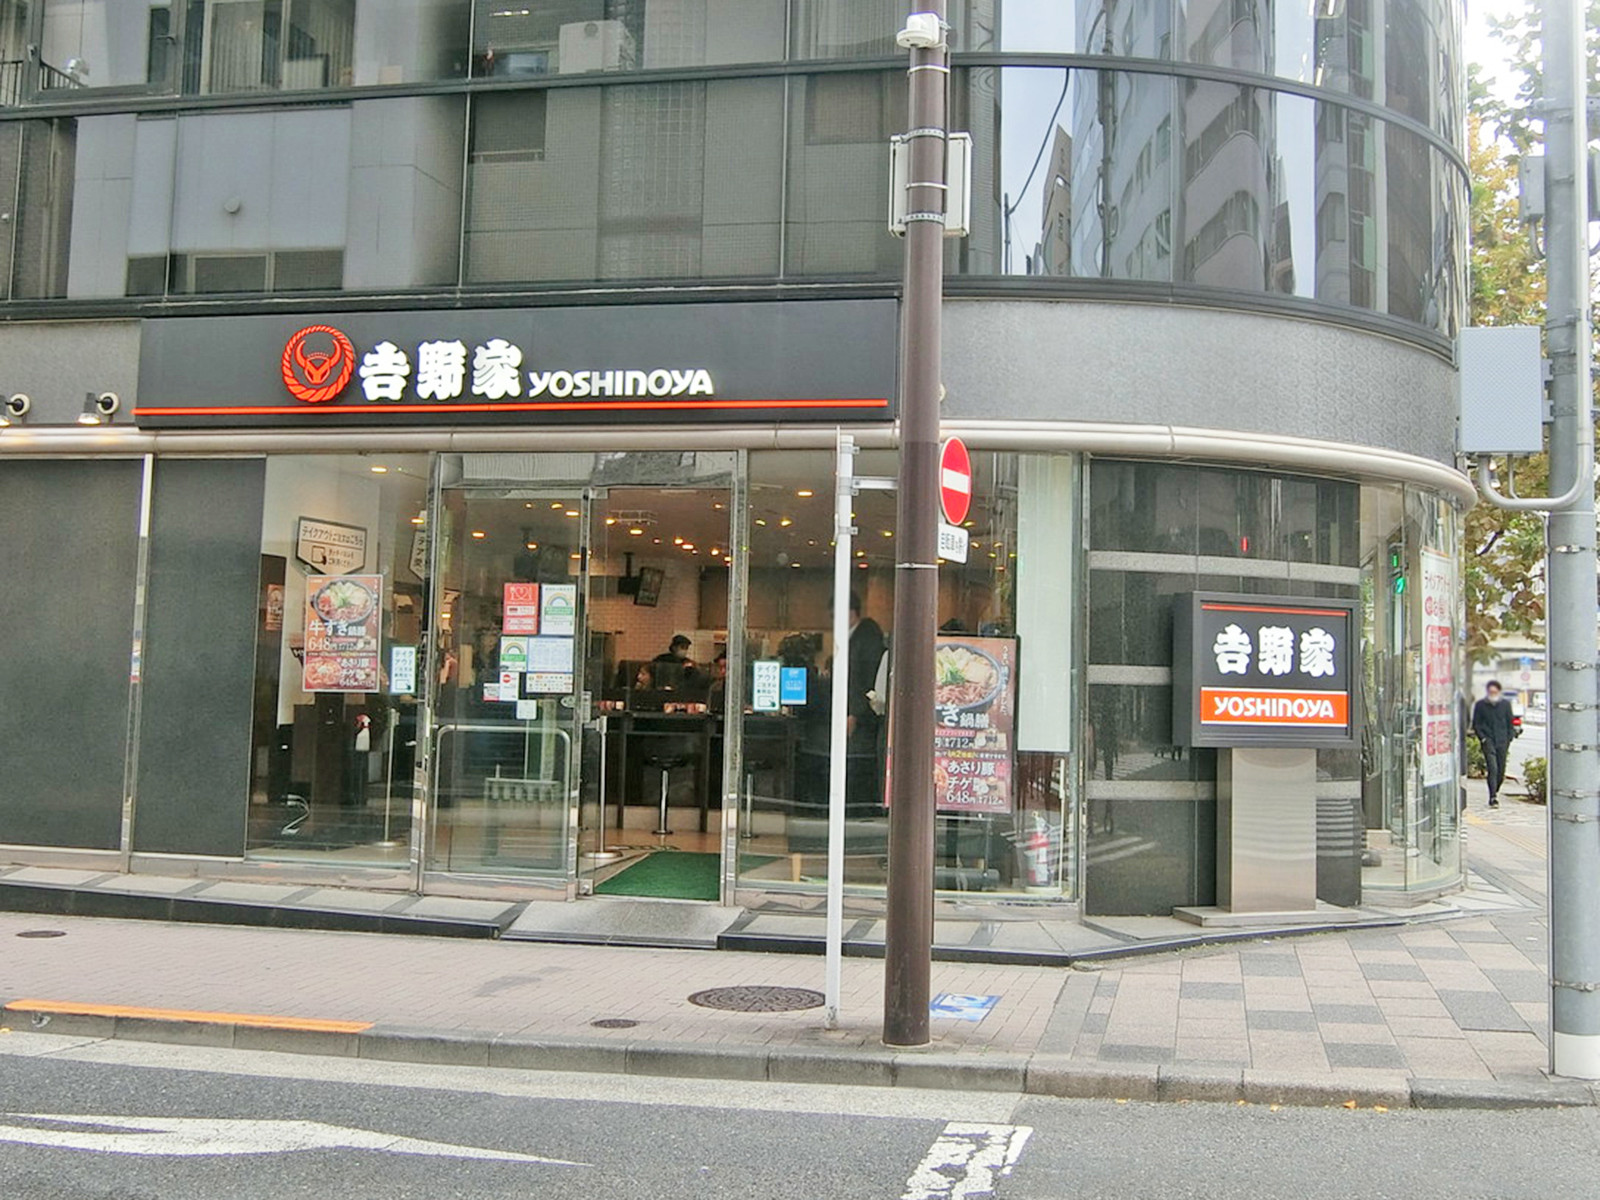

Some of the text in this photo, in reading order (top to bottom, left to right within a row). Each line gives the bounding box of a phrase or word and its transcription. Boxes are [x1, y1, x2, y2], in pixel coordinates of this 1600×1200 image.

[358, 339, 714, 400] 吉野家 YOSHINOYA
[1213, 624, 1336, 677] 吉野家
[935, 702, 989, 729] き鍋膳
[1214, 696, 1334, 718] YOSHINOYA
[948, 760, 995, 776] あさり豚
